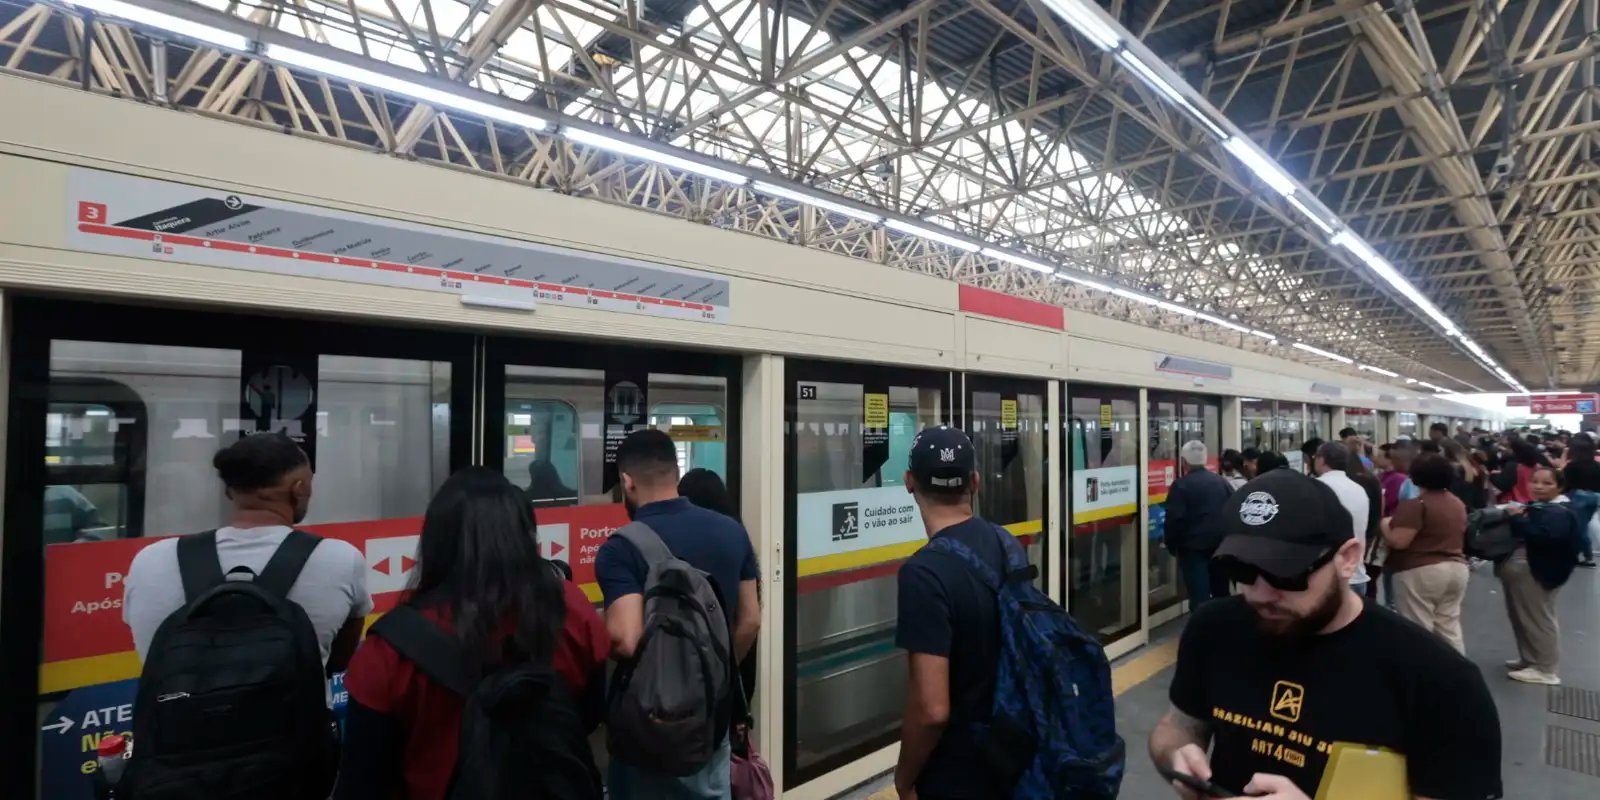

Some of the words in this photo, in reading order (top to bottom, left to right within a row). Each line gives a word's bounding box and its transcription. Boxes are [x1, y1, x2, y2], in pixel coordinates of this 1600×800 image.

[86, 206, 99, 219] 3
[802, 387, 814, 398] 51
[864, 505, 897, 518] Cuidado
[898, 505, 914, 514] com
[864, 521, 870, 529] o
[871, 518, 887, 528] vão
[888, 518, 898, 526] ao
[899, 514, 913, 524] sair
[70, 597, 121, 615] Após
[81, 703, 133, 729] ATE
[1212, 706, 1286, 737] BRAZILIAN
[1287, 729, 1314, 747] JIU
